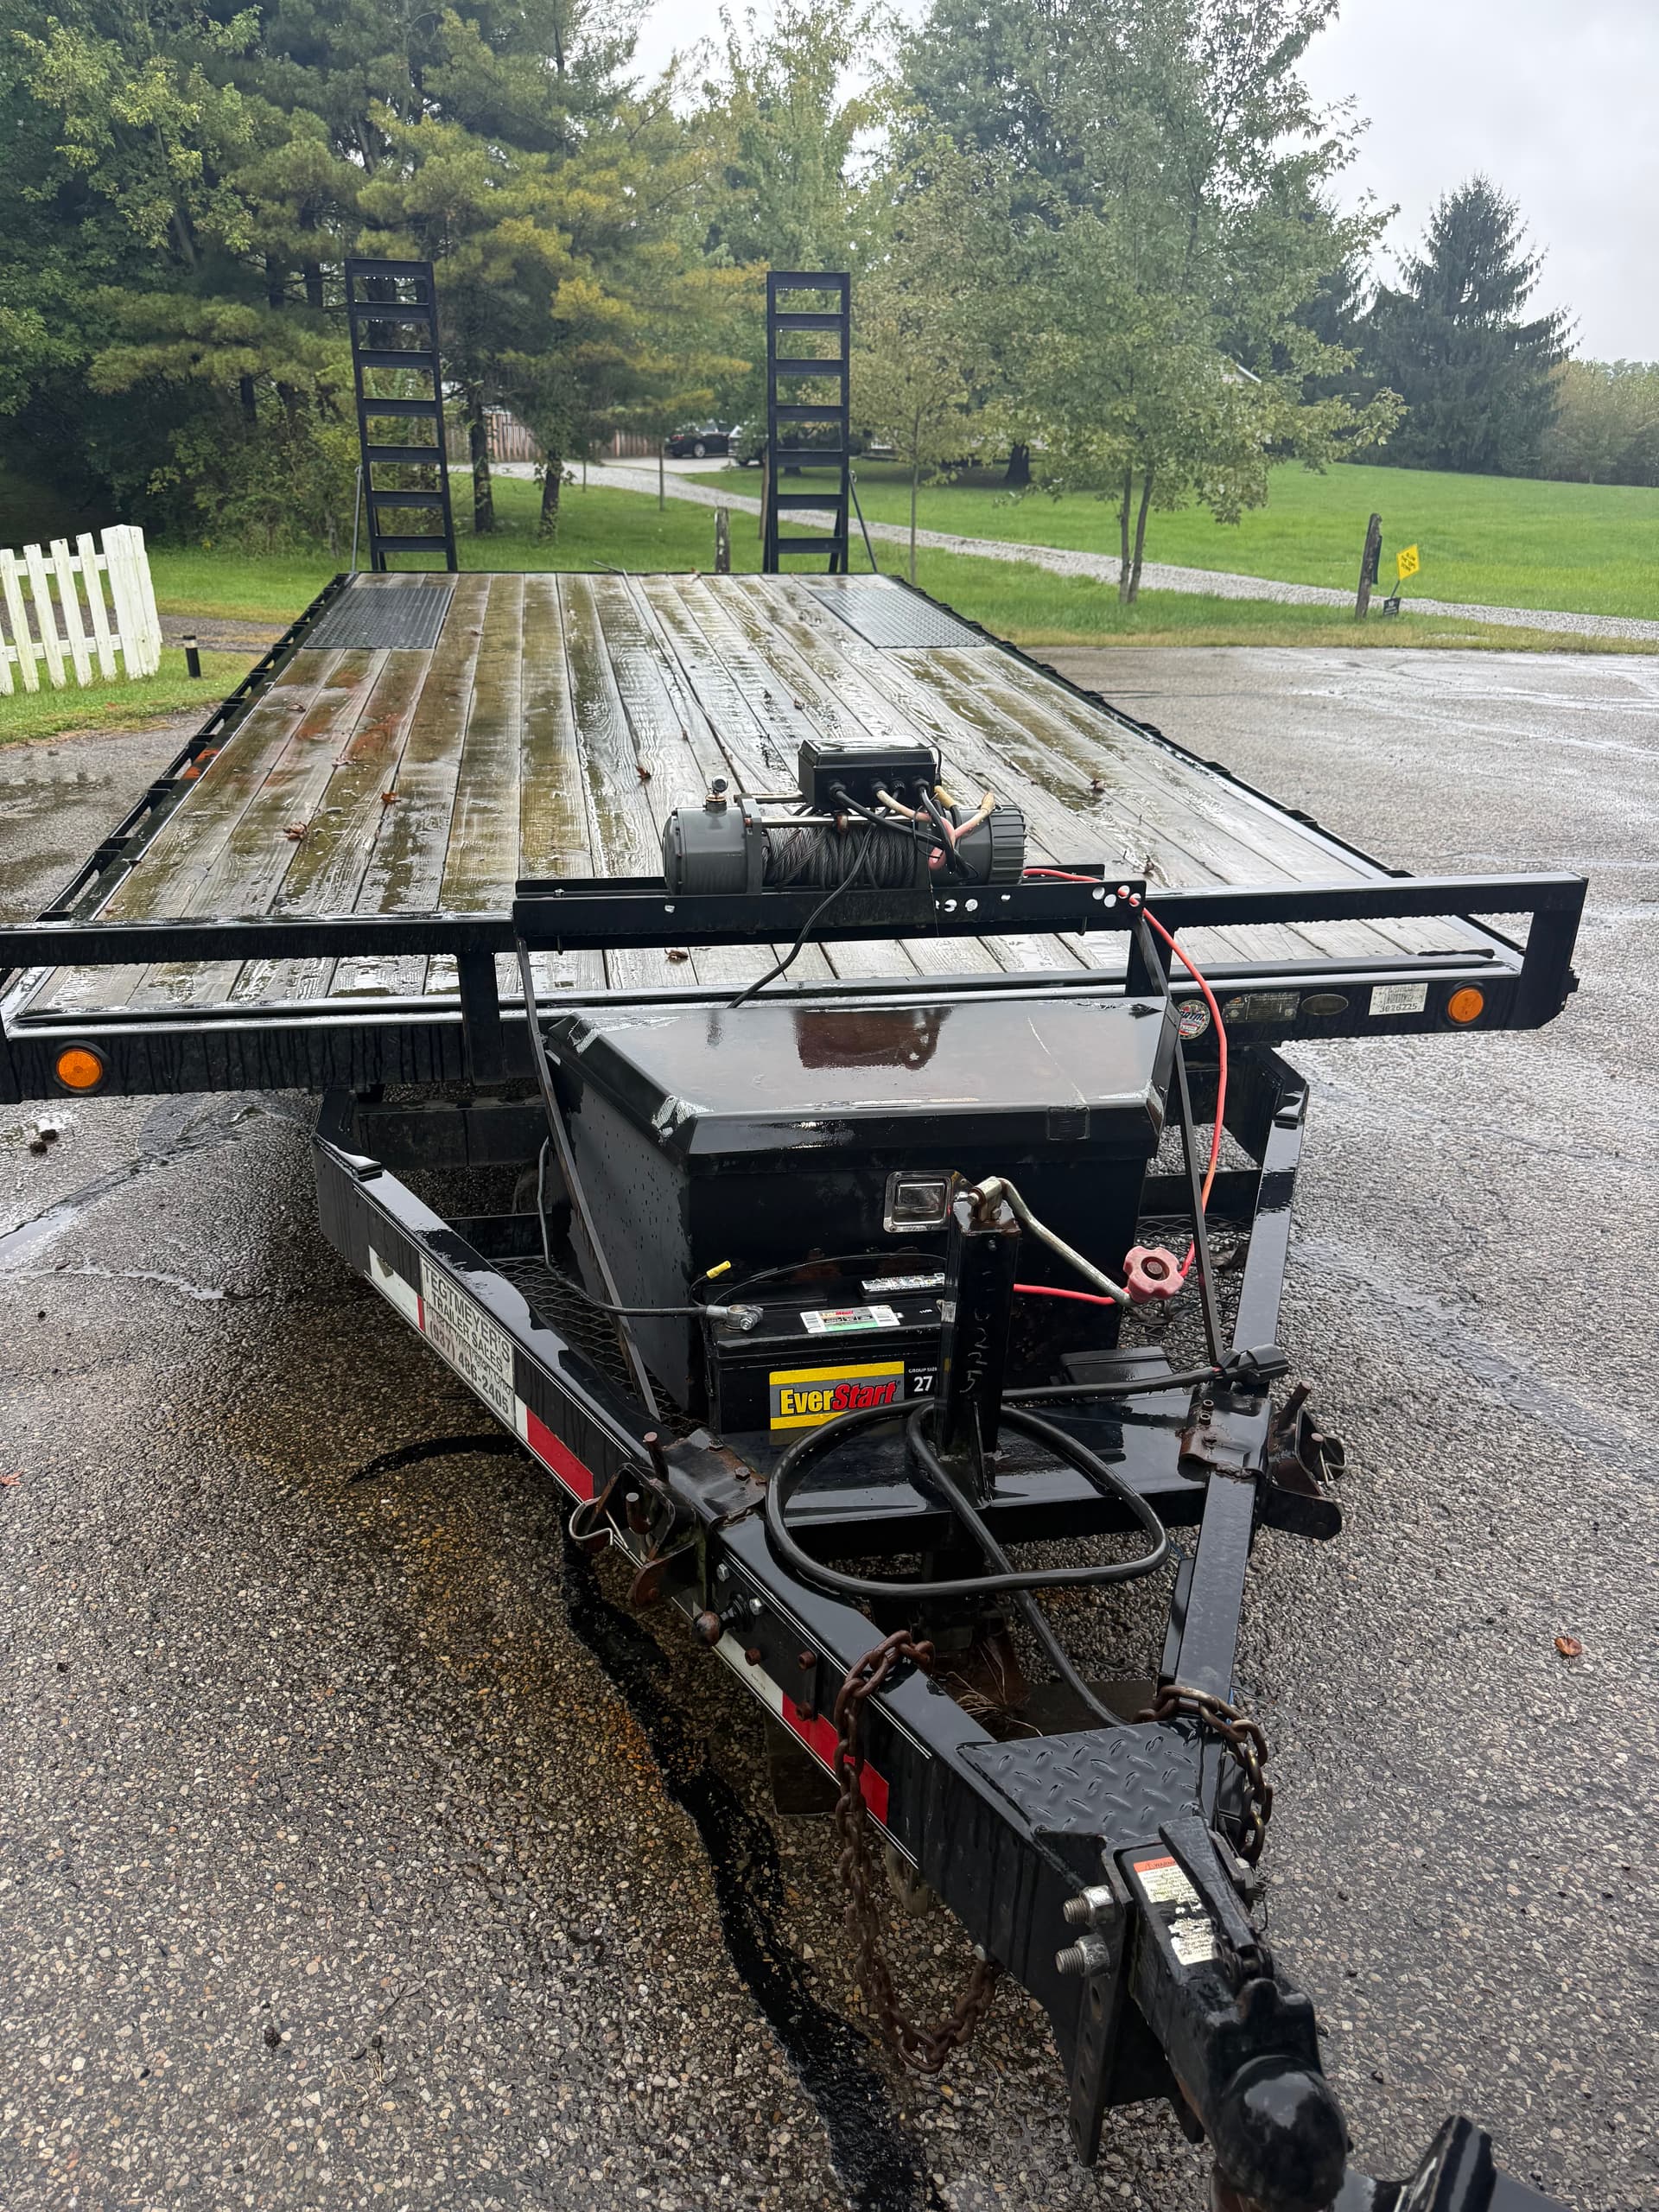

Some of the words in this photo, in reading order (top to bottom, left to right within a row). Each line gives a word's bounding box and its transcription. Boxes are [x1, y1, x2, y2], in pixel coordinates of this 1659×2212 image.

[423, 1262, 511, 1363] TEGTMEYER'S
[432, 1292, 469, 1340] TRAILER
[471, 1332, 503, 1374] SALES
[429, 1320, 455, 1362] (937)
[458, 1351, 509, 1414] 486-2405
[779, 1380, 897, 1416] EverStart
[913, 1376, 933, 1392] 27
